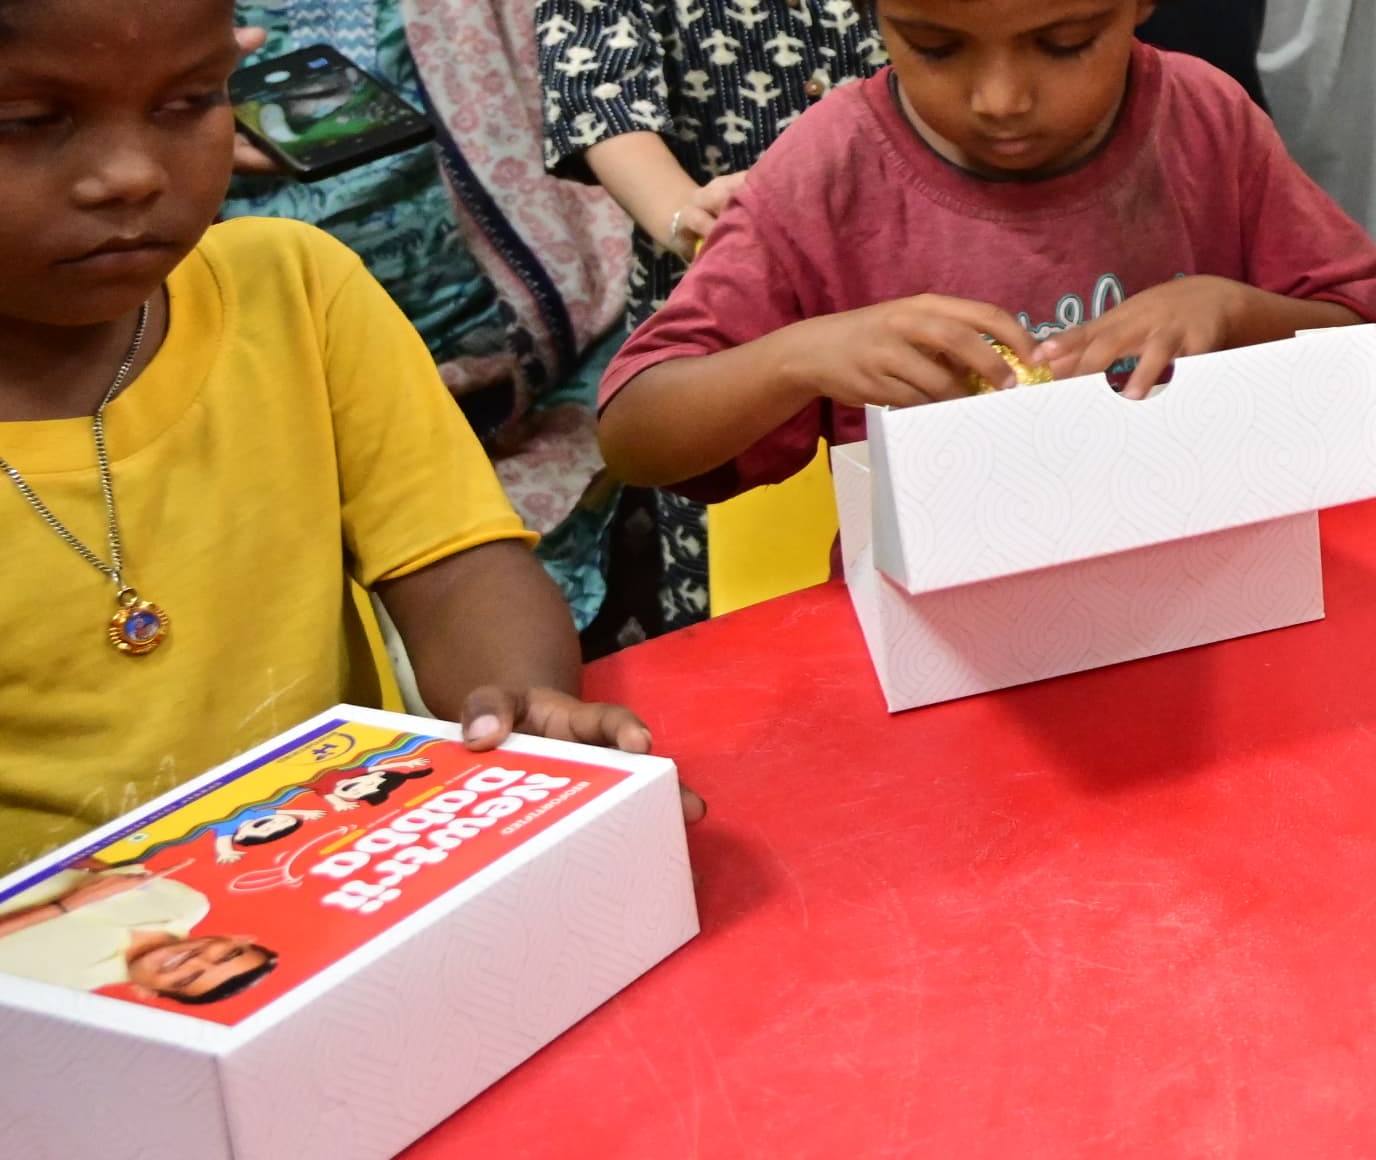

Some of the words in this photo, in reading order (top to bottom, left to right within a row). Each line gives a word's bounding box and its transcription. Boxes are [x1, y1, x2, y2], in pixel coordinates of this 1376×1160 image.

[309, 766, 526, 878] Dabba
[320, 773, 571, 914] Newtrii
[500, 781, 591, 835] BIOFORTIFIED
